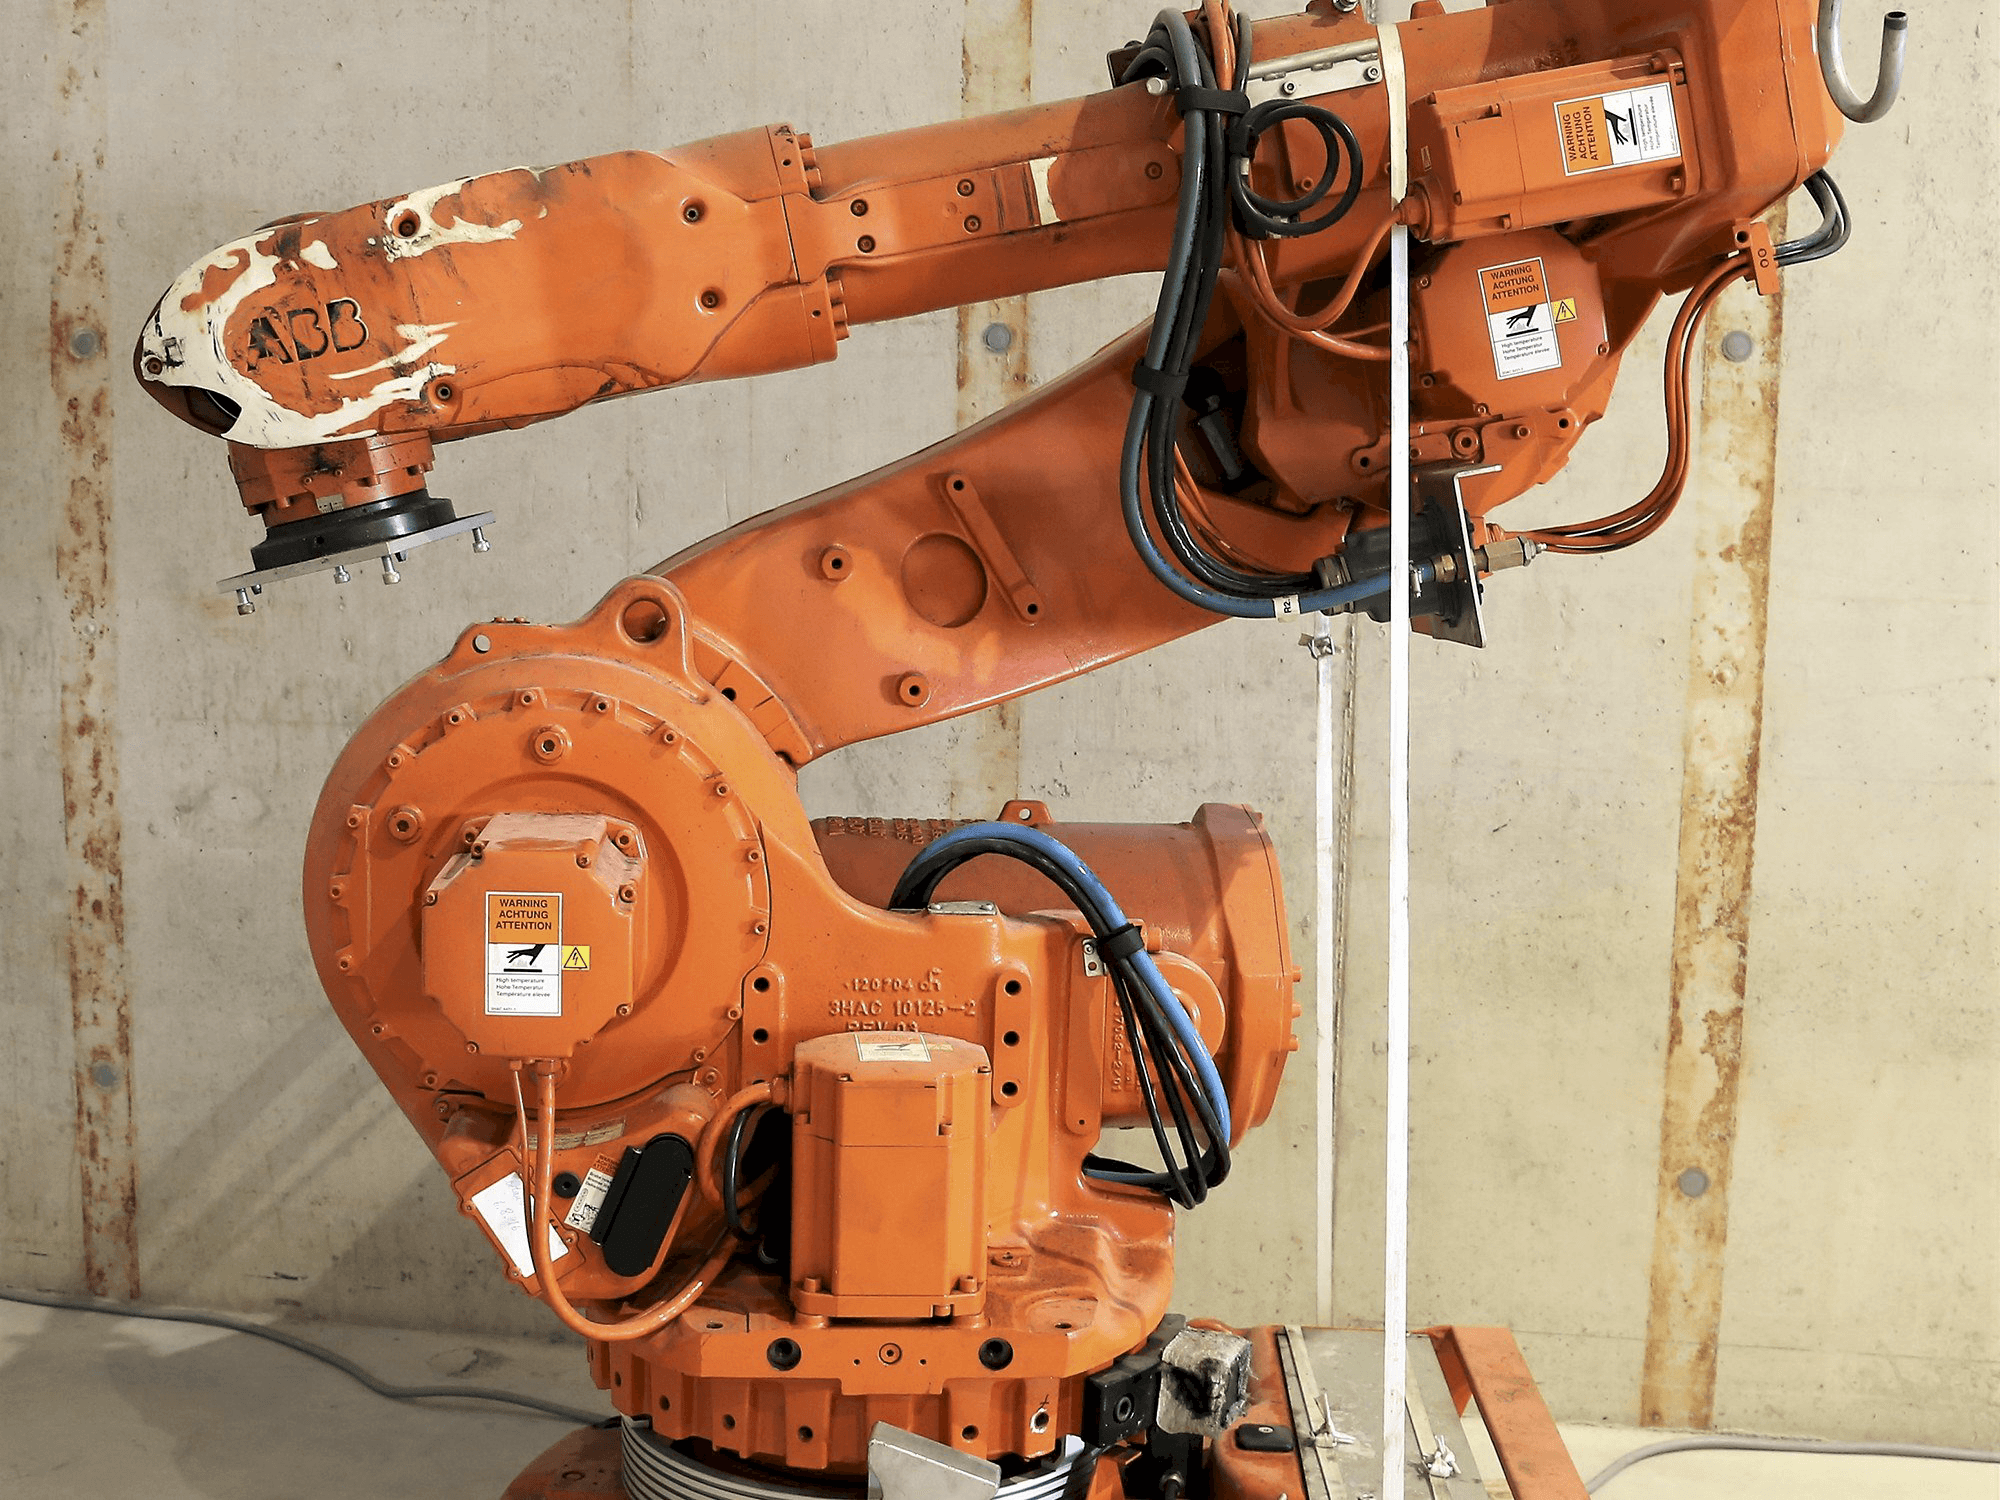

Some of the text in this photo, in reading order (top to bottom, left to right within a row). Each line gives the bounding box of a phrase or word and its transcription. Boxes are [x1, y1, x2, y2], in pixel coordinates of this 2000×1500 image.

[1563, 114, 1576, 161] WARNING
[1573, 111, 1588, 159] ACHTUNG
[1583, 106, 1598, 160] ATTENTION
[1491, 265, 1532, 280] WARNING
[1493, 275, 1535, 290] ACHTUNG
[1492, 284, 1539, 300] ATTENTION
[247, 297, 369, 372] ABB
[1514, 336, 1542, 345] temperature
[499, 899, 548, 908] WARNING
[499, 910, 548, 919] ACHTUNG
[495, 921, 552, 930] ATTENTION
[829, 1000, 883, 1016] 3HAC
